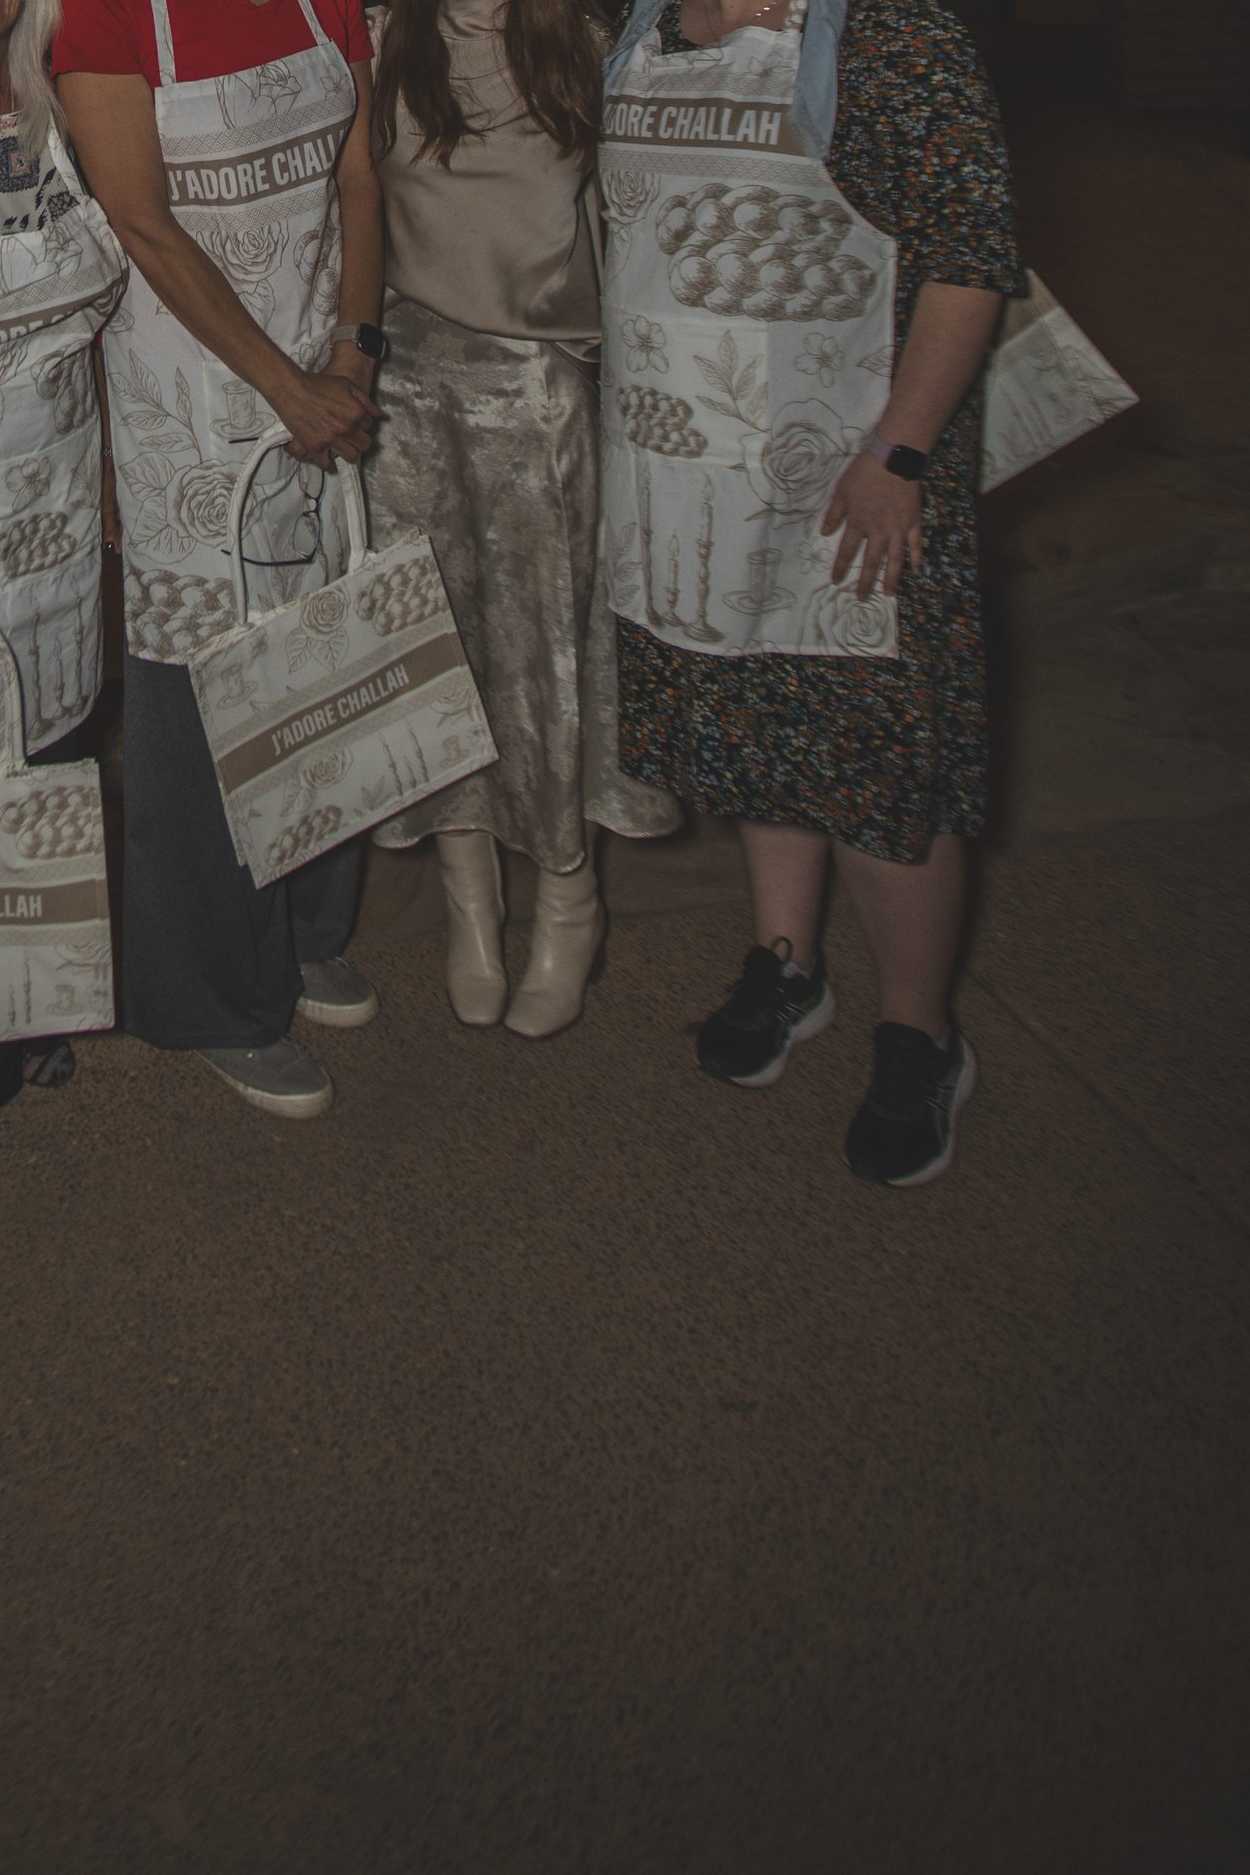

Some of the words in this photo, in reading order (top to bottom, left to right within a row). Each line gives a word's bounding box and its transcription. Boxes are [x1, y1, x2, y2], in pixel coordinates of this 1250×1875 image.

[601, 102, 659, 138] DORE
[658, 105, 782, 146] CHALLAH
[168, 157, 270, 202] J'ADORE
[271, 125, 350, 187] CHALL
[270, 706, 338, 757] J'ADORE
[337, 663, 410, 719] CHALLAH
